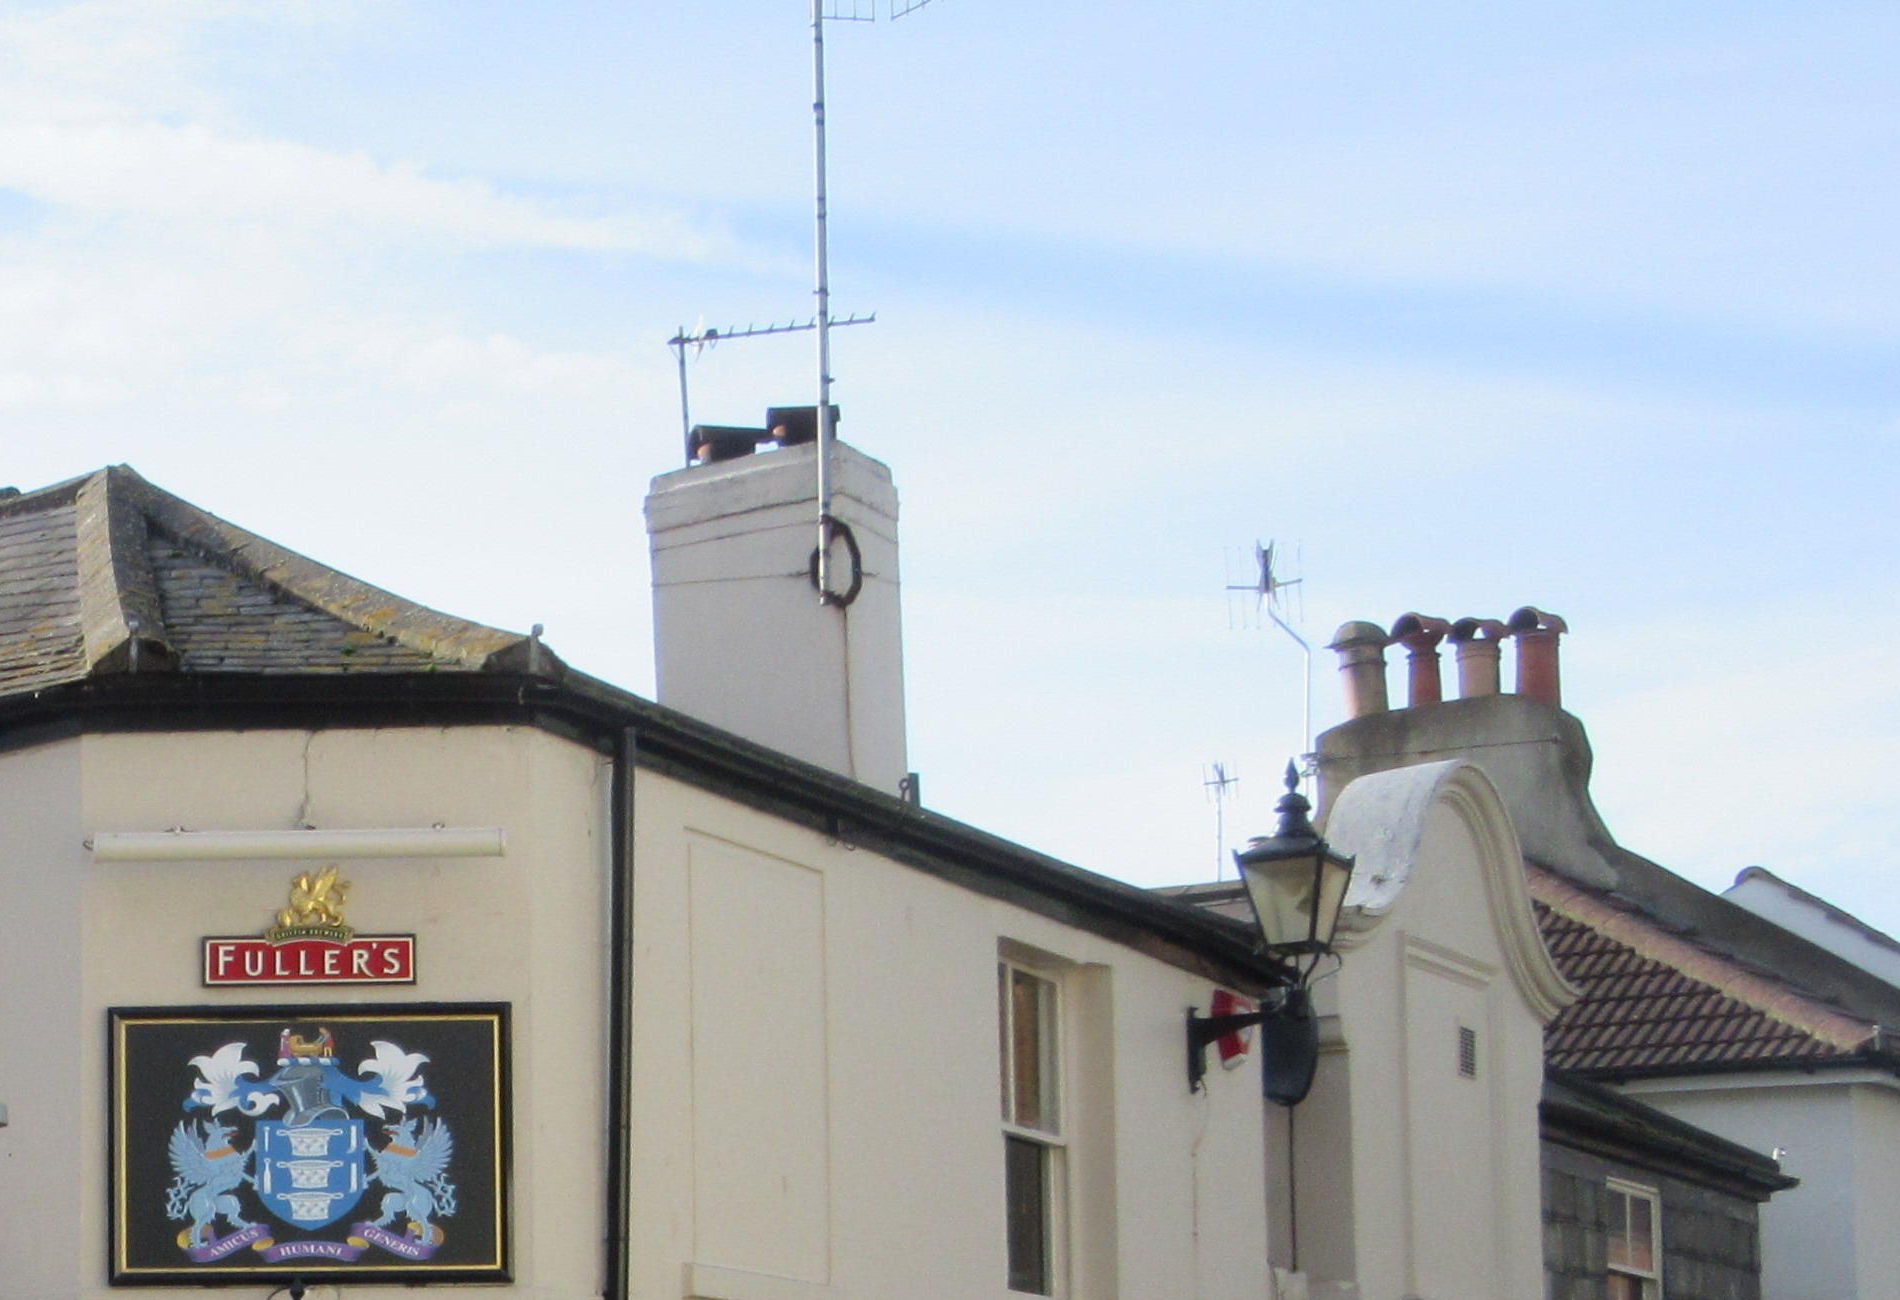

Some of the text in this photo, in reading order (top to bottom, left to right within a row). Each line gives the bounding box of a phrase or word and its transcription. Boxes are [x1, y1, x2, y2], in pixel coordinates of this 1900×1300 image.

[217, 942, 401, 978] FULLER'S
[209, 1228, 420, 1257] AMICUS HUMANI GENERIS
